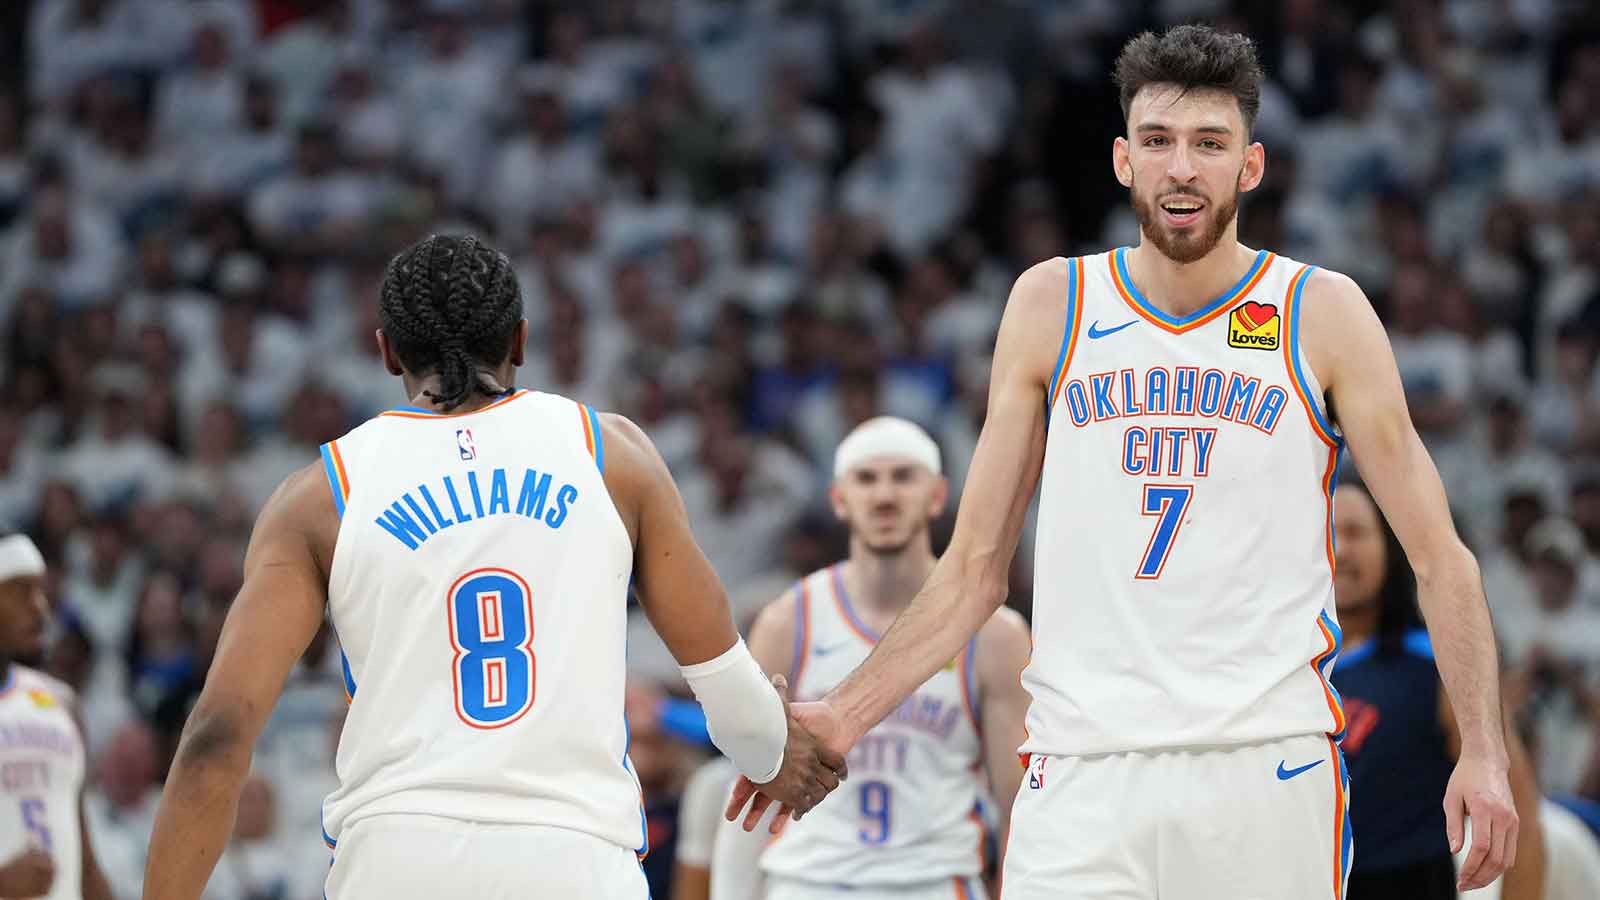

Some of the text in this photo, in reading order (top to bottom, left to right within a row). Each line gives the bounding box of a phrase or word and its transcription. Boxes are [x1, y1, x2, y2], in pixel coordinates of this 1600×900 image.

[1065, 367, 1288, 436] OKLAHOMA
[1122, 426, 1217, 477] CITY
[374, 468, 578, 551] WILLIAMS
[1135, 484, 1194, 579] 7
[447, 567, 537, 730] 8
[857, 778, 893, 847] 9
